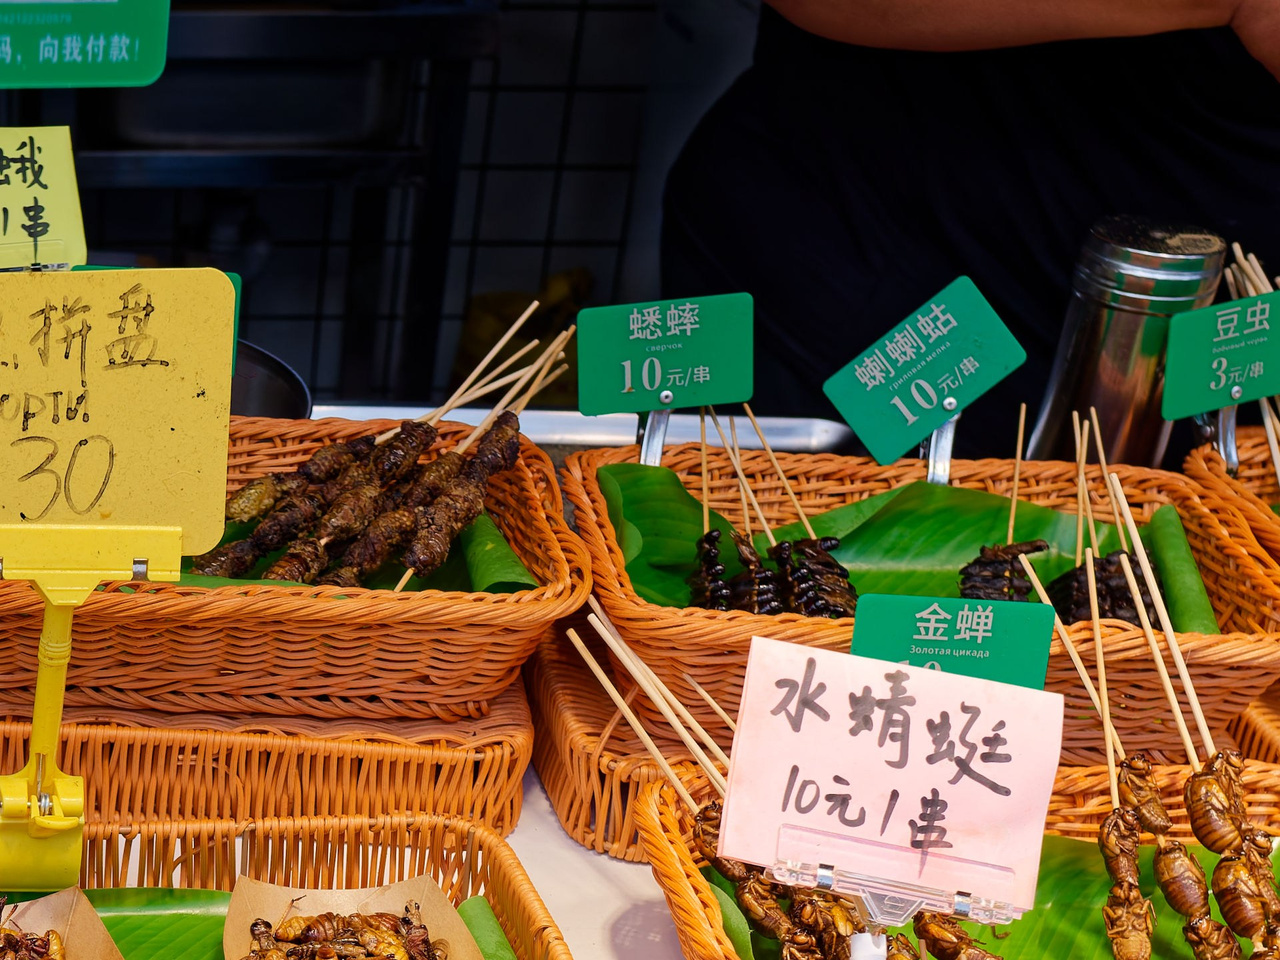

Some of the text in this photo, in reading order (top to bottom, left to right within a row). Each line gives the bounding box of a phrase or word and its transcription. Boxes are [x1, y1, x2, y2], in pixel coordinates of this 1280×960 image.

[629, 302, 700, 341] 蟋蟀
[1213, 300, 1270, 342] 豆虫
[621, 357, 710, 393] 10元/串
[889, 355, 980, 427] 10元/串
[1210, 357, 1264, 390] 3元/串
[913, 602, 993, 643] 金蝉
[909, 645, 990, 659] Золотая цикада
[770, 657, 1012, 796] 水蜻蜓
